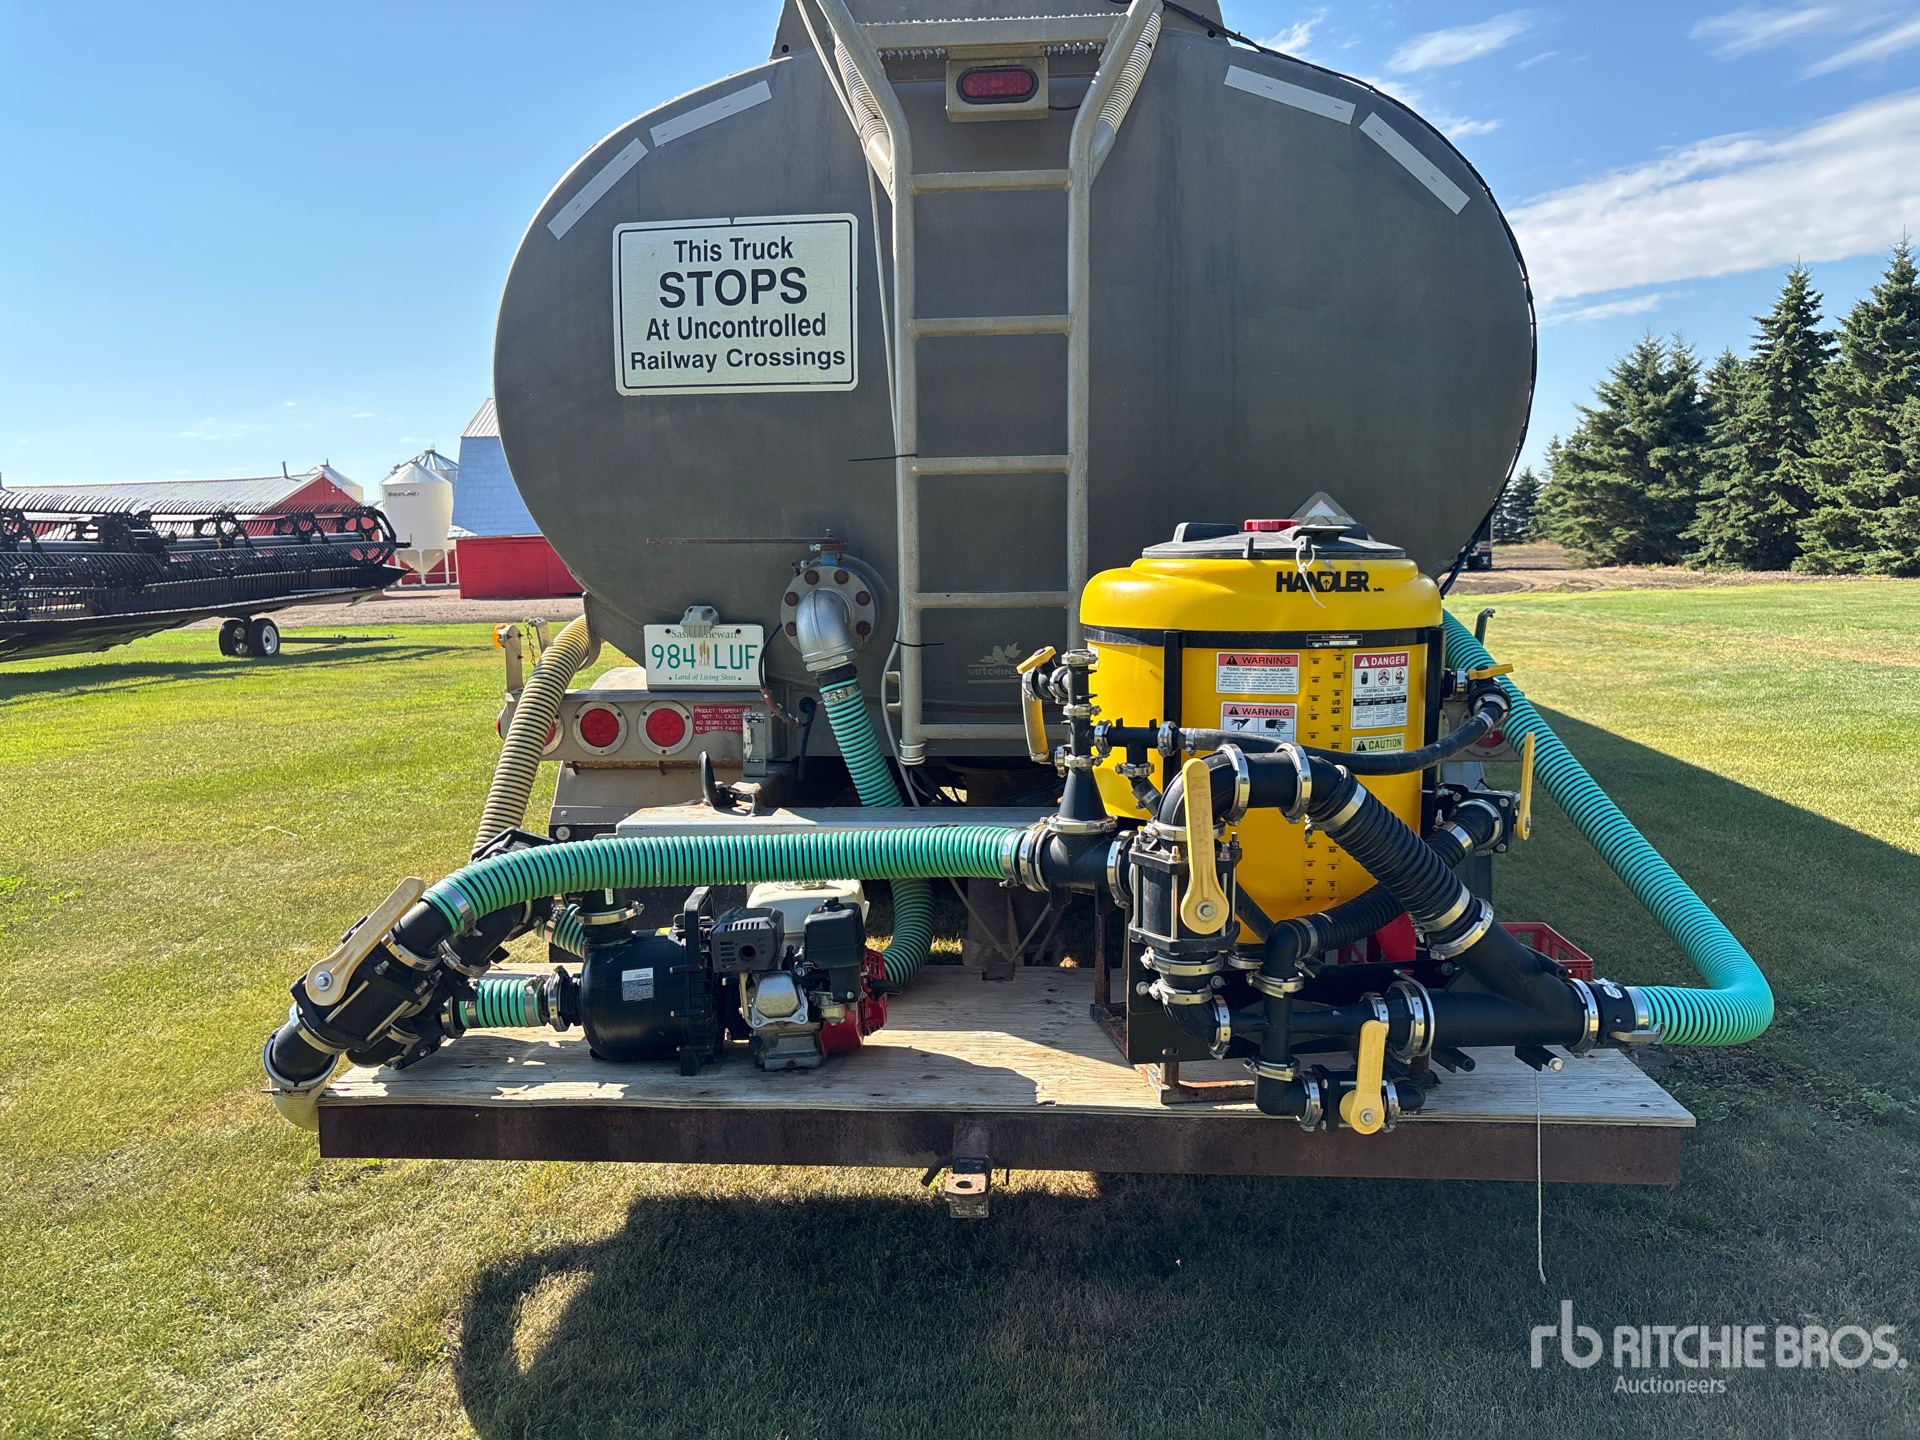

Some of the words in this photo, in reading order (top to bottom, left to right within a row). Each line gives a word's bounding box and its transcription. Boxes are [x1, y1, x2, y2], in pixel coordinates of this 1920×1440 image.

[673, 239, 722, 263] This
[729, 236, 794, 260] Truck
[659, 266, 808, 309] STOPS
[646, 317, 670, 341] At
[677, 312, 826, 340] Uncontrolled
[631, 351, 718, 373] Railway
[726, 347, 846, 370] Crossings
[1276, 571, 1370, 592] HANDLER
[651, 644, 696, 669] 984
[714, 644, 758, 669] LUF
[1242, 656, 1291, 665] WARNING
[1371, 656, 1405, 666] DANGER
[1242, 708, 1290, 716] WARNING
[1368, 738, 1402, 750] CAUTION
